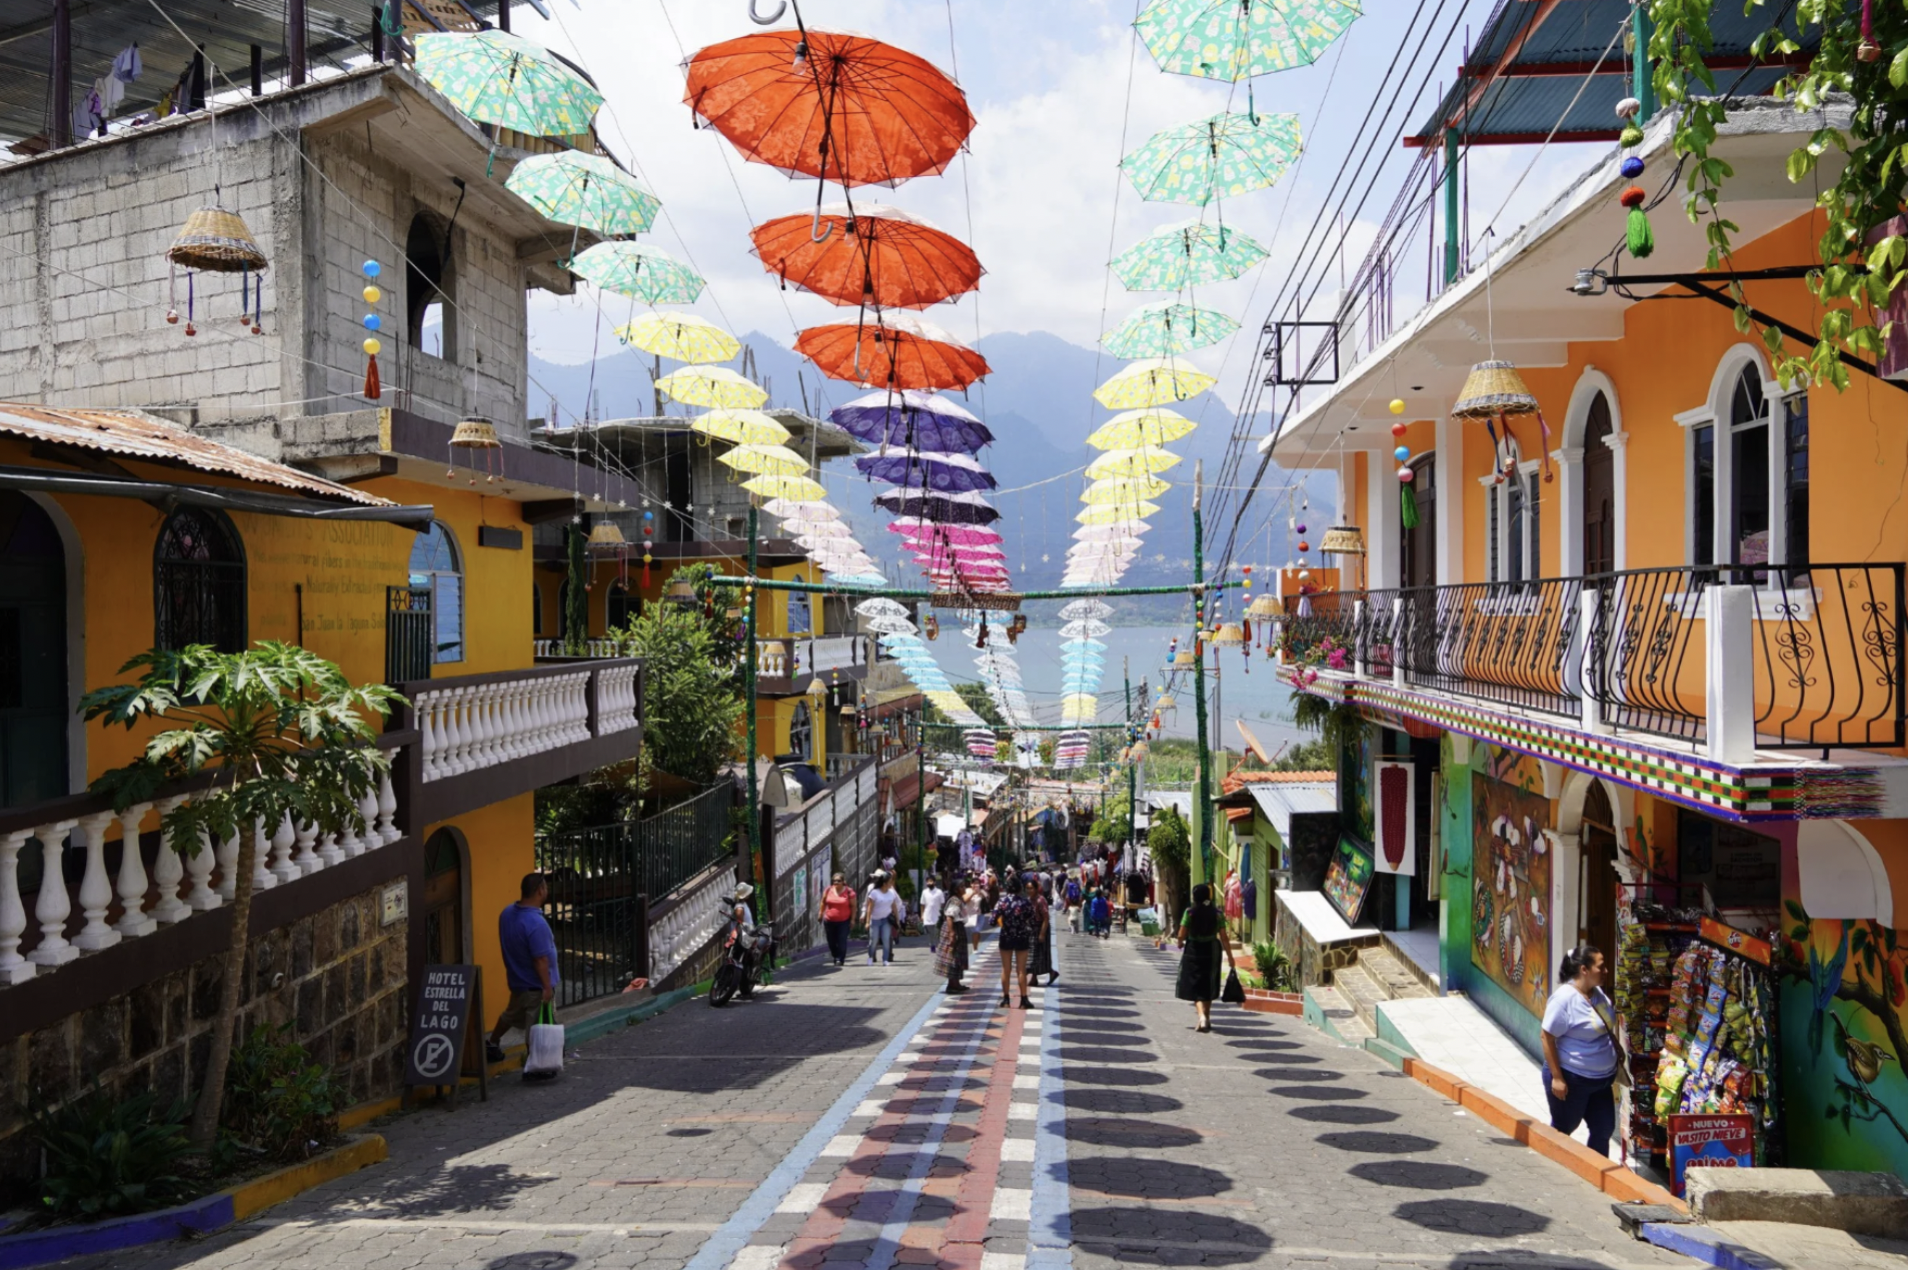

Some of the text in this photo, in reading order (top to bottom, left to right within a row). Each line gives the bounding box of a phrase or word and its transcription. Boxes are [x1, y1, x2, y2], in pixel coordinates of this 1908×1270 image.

[317, 614, 335, 631] Juan
[428, 972, 466, 986] HOTEL
[424, 986, 465, 999] ESTRELLA
[432, 1000, 450, 1012] DEL
[420, 1014, 458, 1030] LAGO
[1692, 1120, 1729, 1129] NUEVO
[1678, 1128, 1742, 1145] VASITO NIEVE
